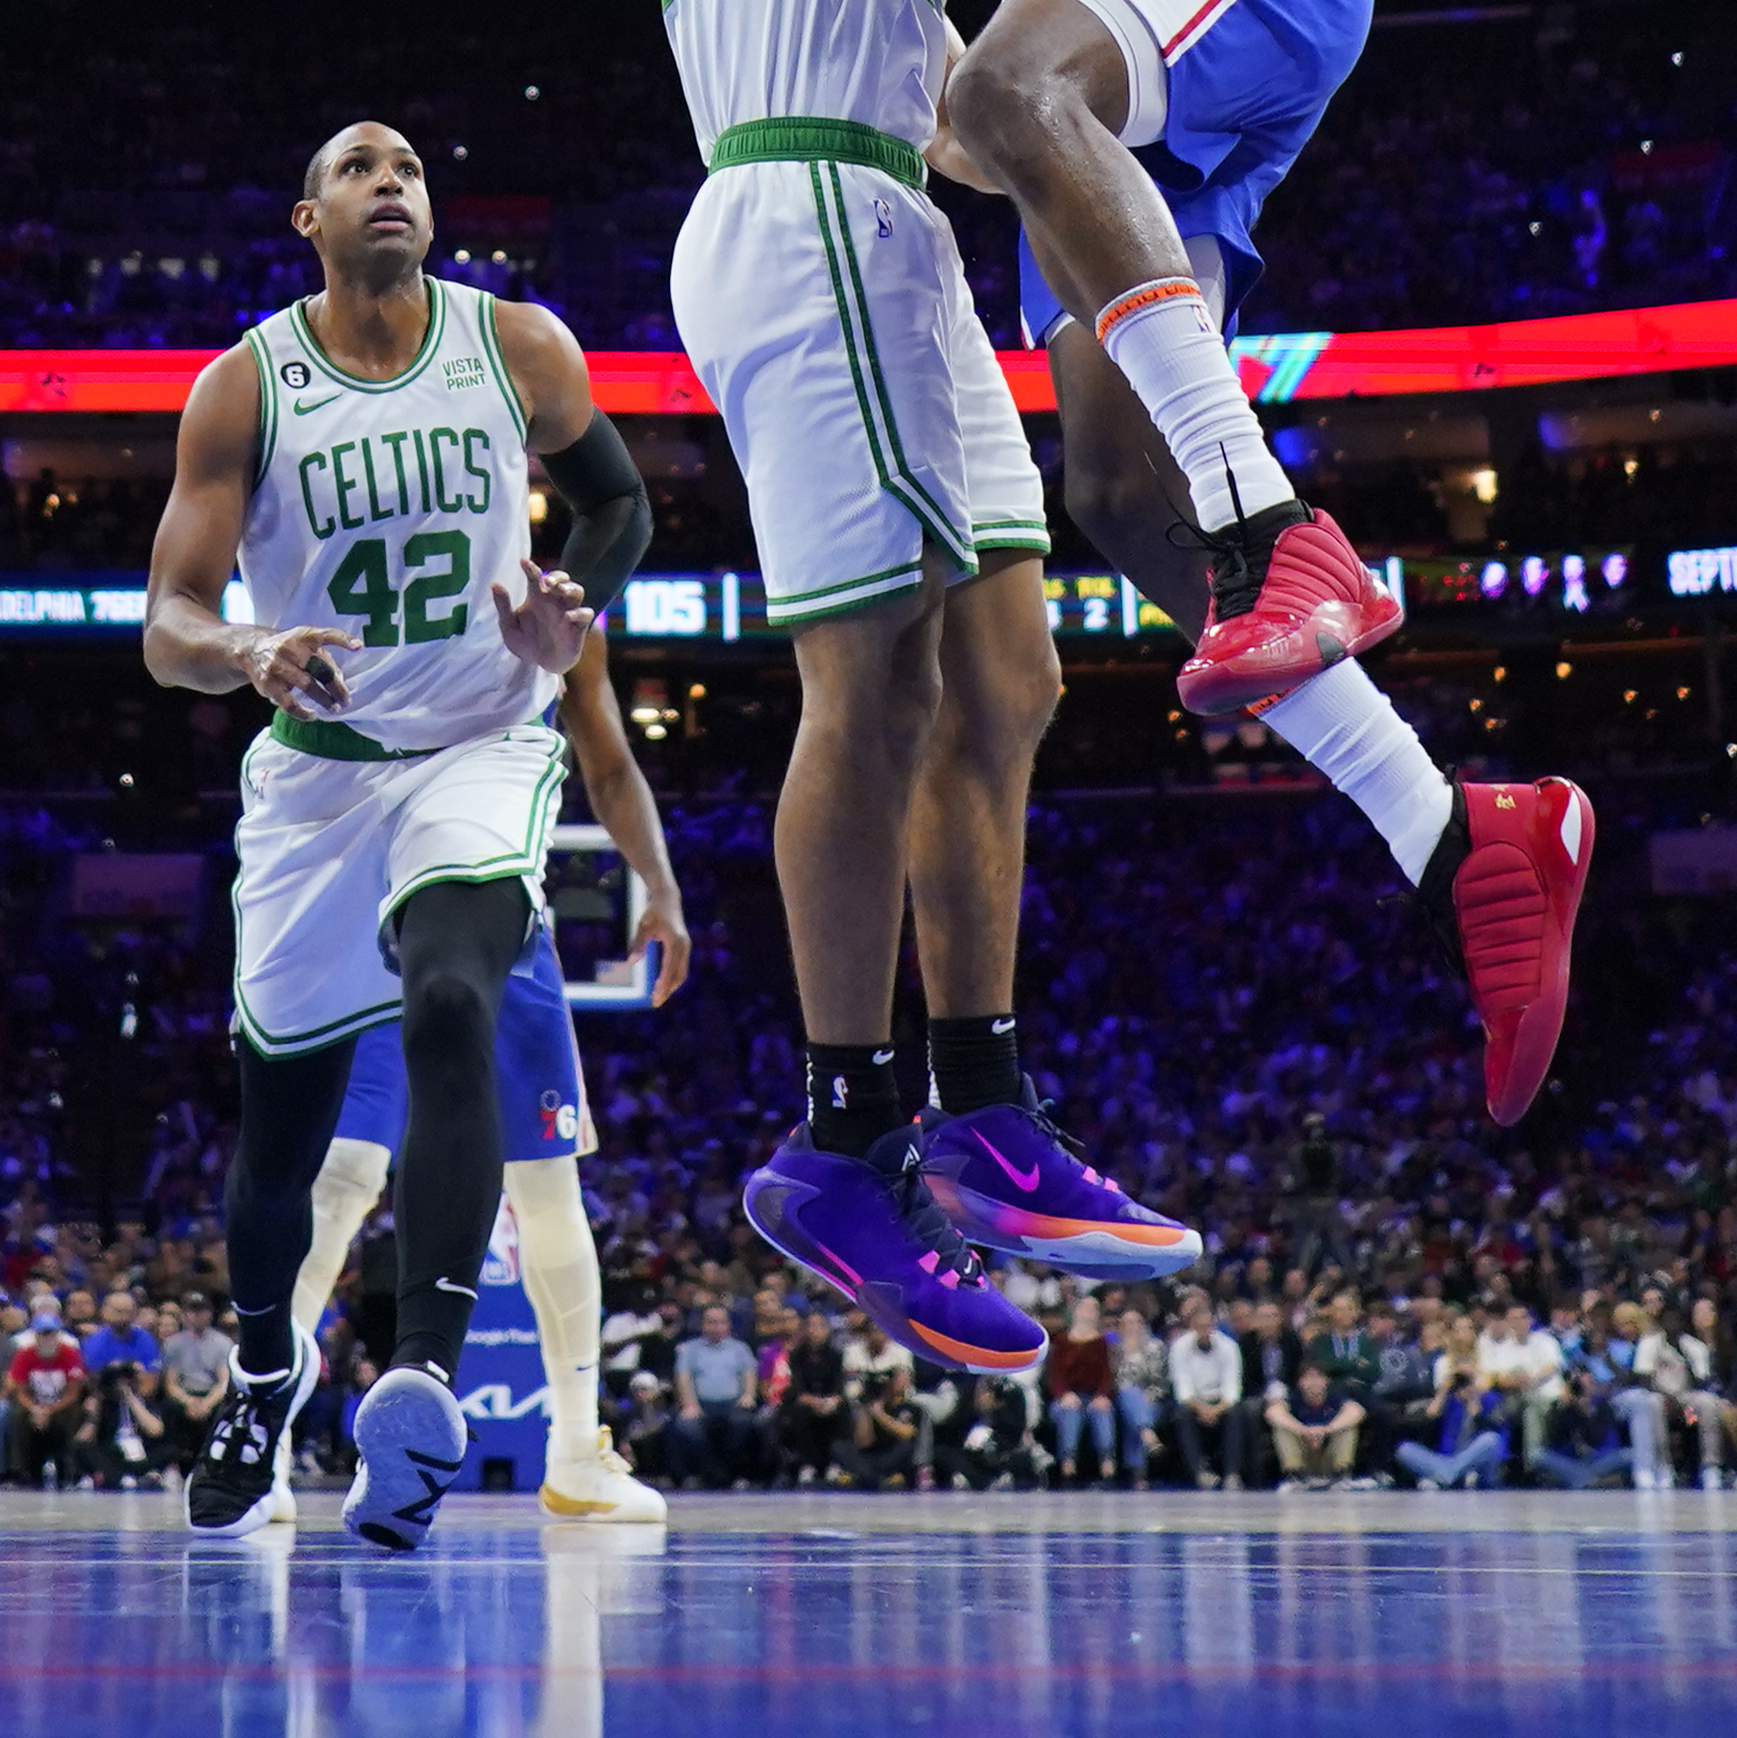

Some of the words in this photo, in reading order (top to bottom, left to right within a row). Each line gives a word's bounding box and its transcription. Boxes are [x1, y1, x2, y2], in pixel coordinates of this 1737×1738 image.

[442, 357, 484, 376] VISTA
[446, 372, 487, 392] PRINT
[298, 427, 491, 540] CELTICS
[327, 529, 472, 649] 42
[623, 580, 707, 637] 105
[1083, 597, 1110, 633] 2
[540, 1104, 578, 1140] 76
